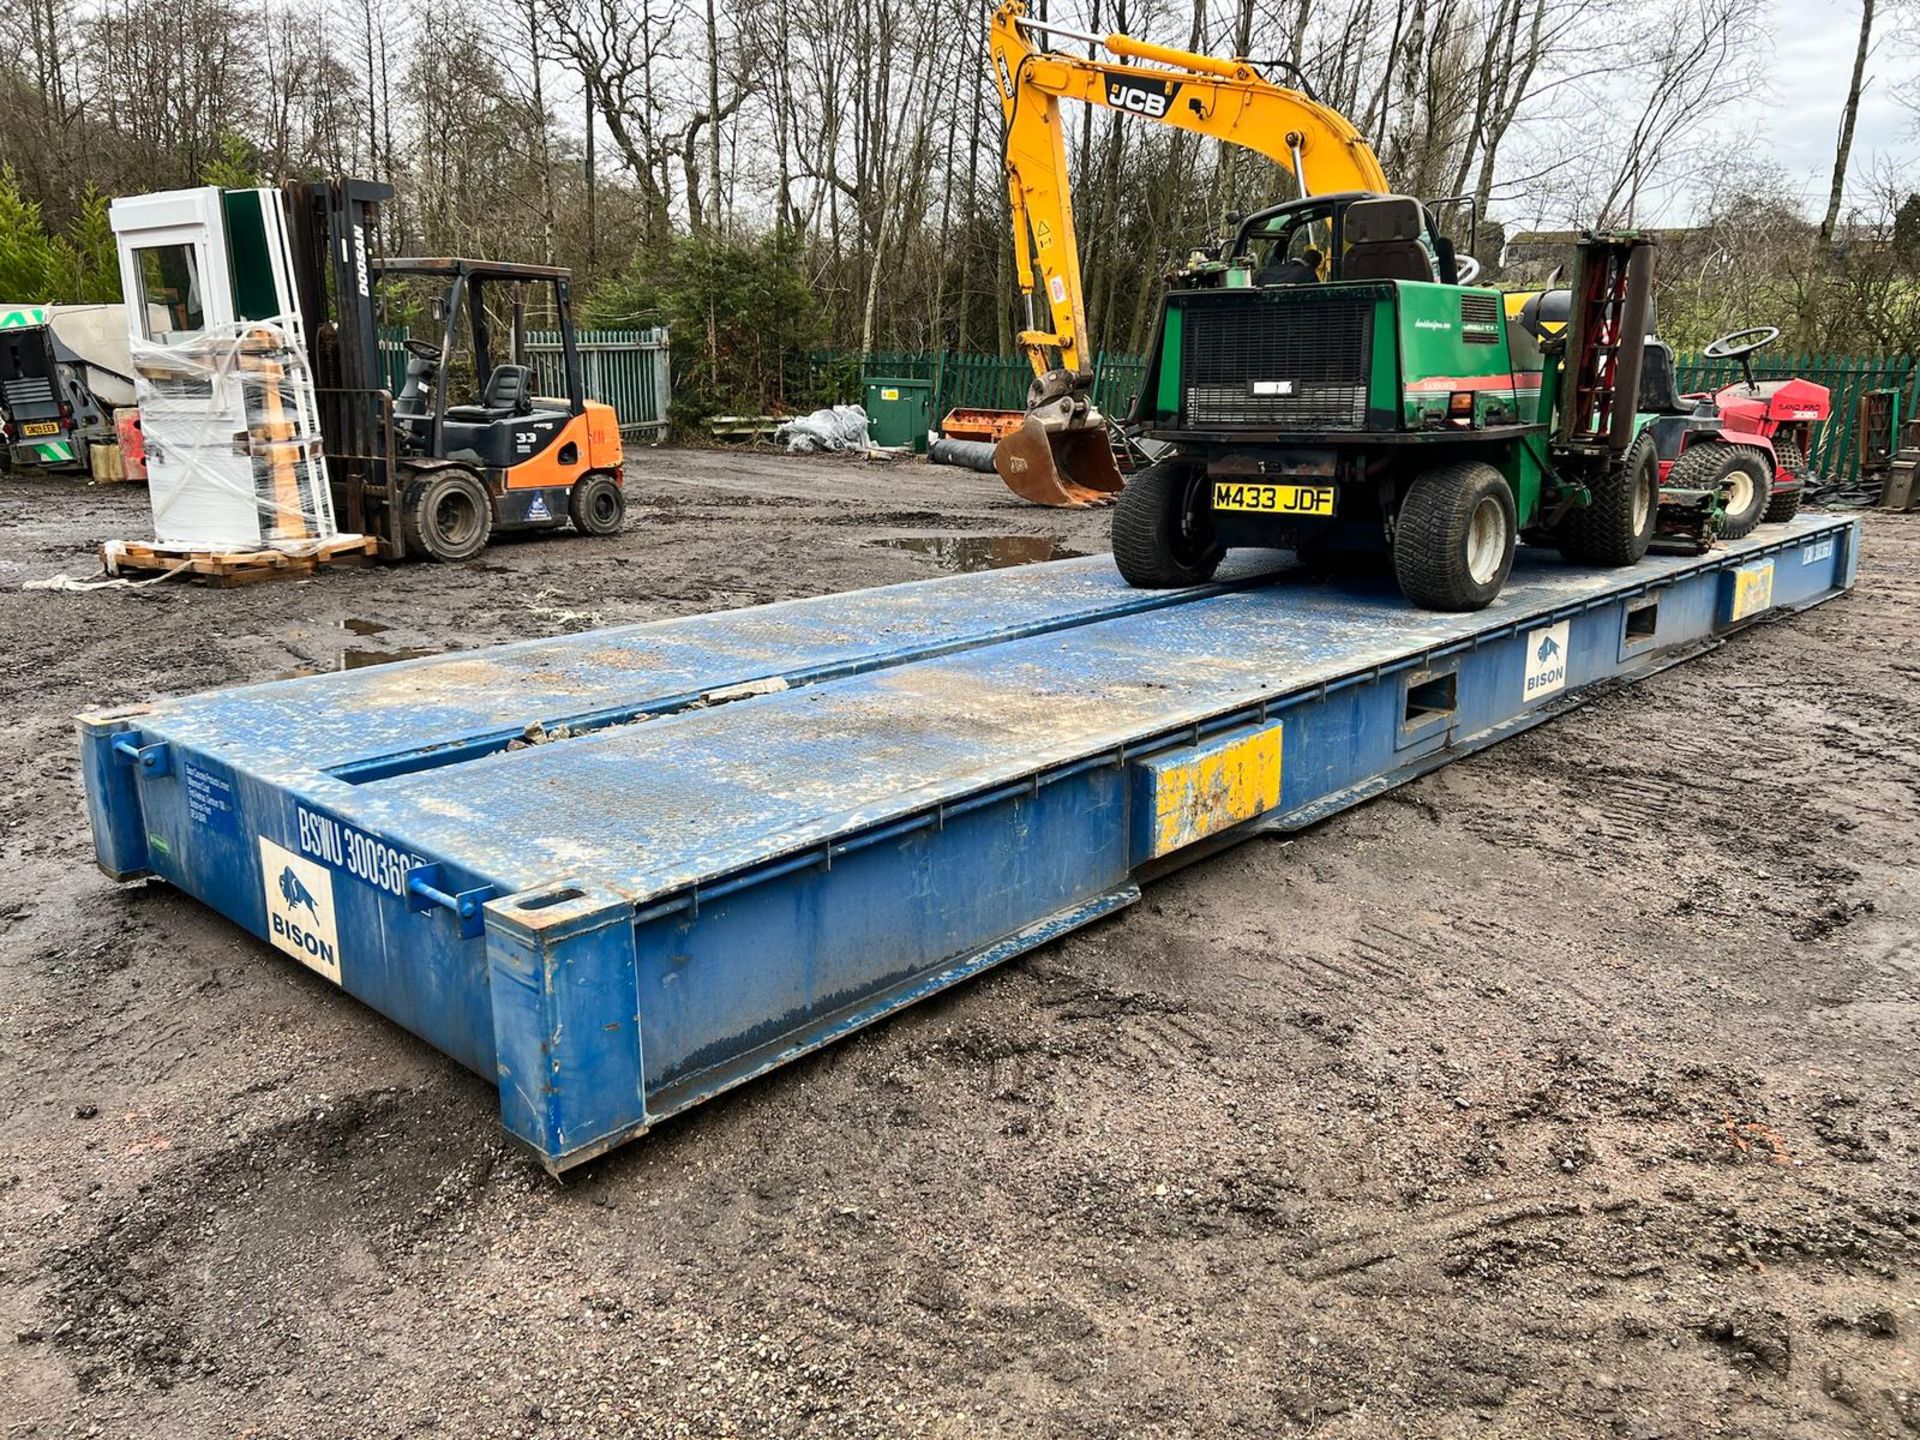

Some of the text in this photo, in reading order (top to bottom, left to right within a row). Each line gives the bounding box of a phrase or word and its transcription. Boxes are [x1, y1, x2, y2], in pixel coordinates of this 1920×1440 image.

[1109, 86, 1166, 116] JCB
[353, 224, 369, 297] DOOSAN
[515, 432, 537, 444] 33
[1217, 485, 1331, 511] M433 JDF
[1527, 665, 1564, 691] BISON
[297, 806, 343, 866] BSWU
[272, 912, 335, 966] BISON
